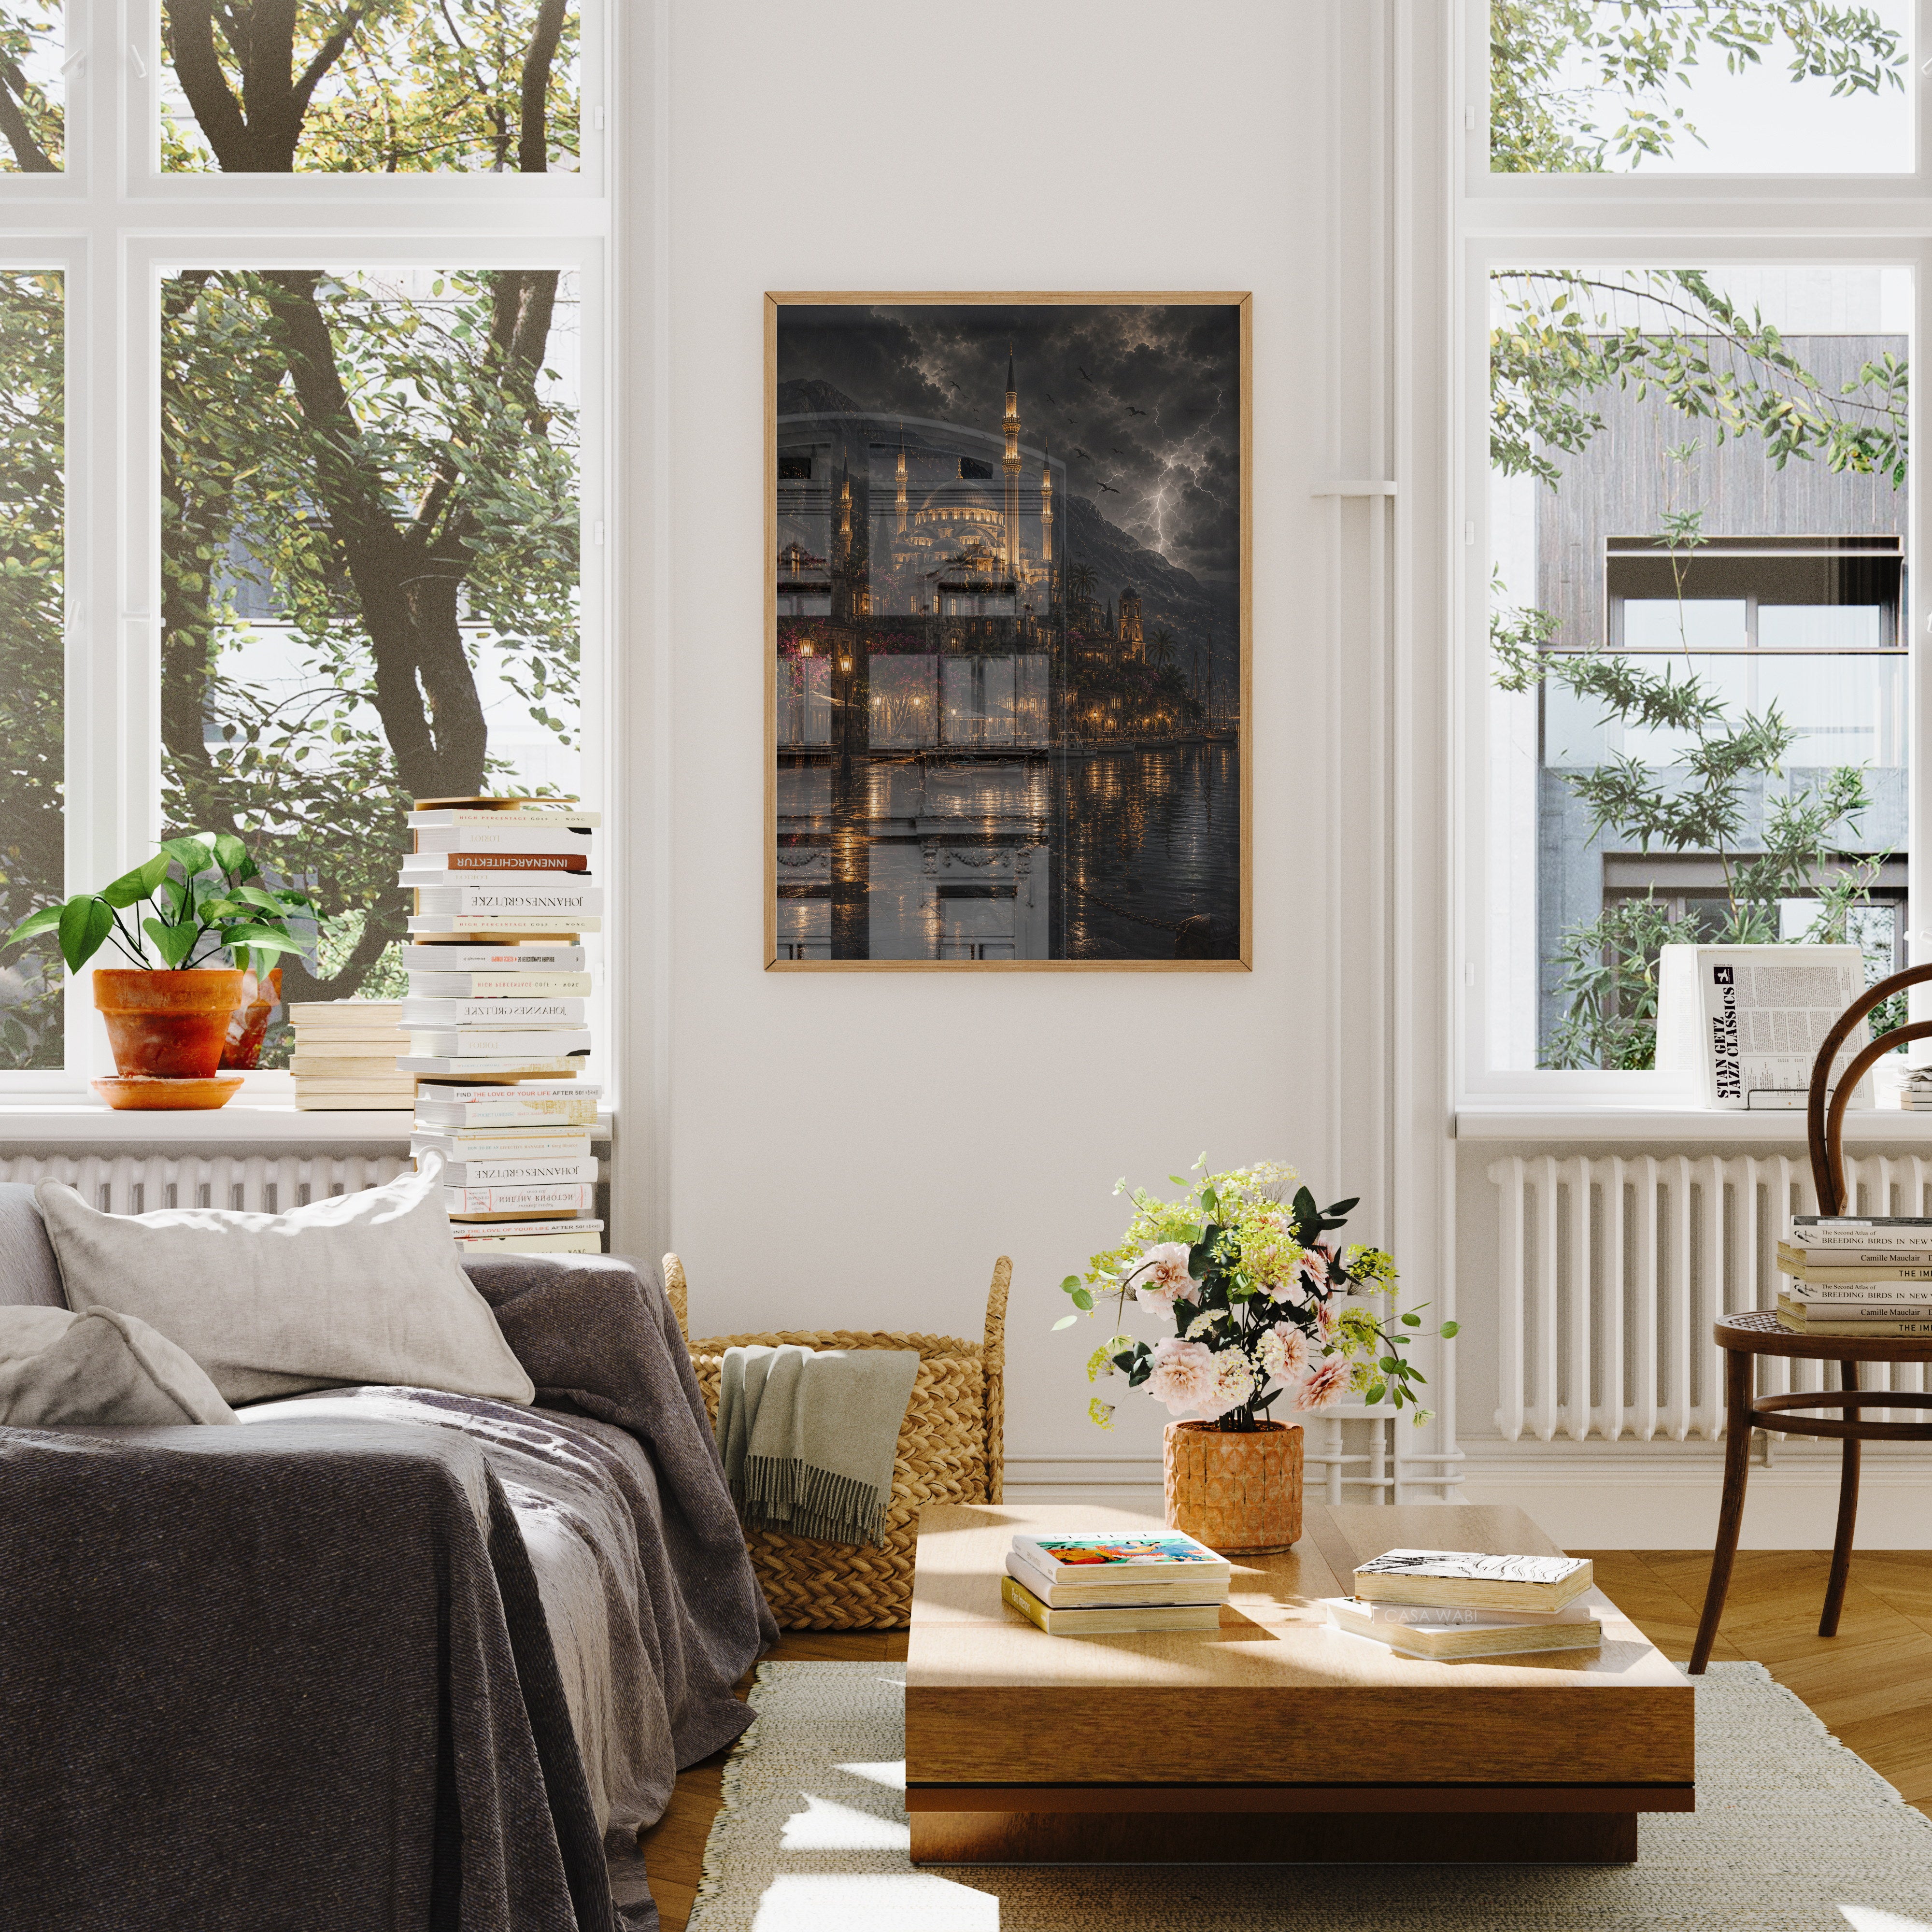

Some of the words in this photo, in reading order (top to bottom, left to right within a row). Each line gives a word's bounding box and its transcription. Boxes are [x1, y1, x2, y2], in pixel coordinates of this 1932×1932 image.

[457, 858, 568, 867] INNENARCHITEKTUR
[471, 897, 524, 908] GRÜTZKE
[526, 897, 583, 907] JOHANNES
[1723, 987, 1739, 1057] CLASSICS
[1713, 1017, 1726, 1054] GETZ
[1715, 1059, 1729, 1098] STAN
[1728, 1062, 1741, 1098] JAZZ
[475, 1168, 525, 1179] GRÜTZKE
[526, 1166, 579, 1177] JOHANNES
[1384, 1609, 1431, 1622] CASA
[1435, 1609, 1477, 1622] WABI
